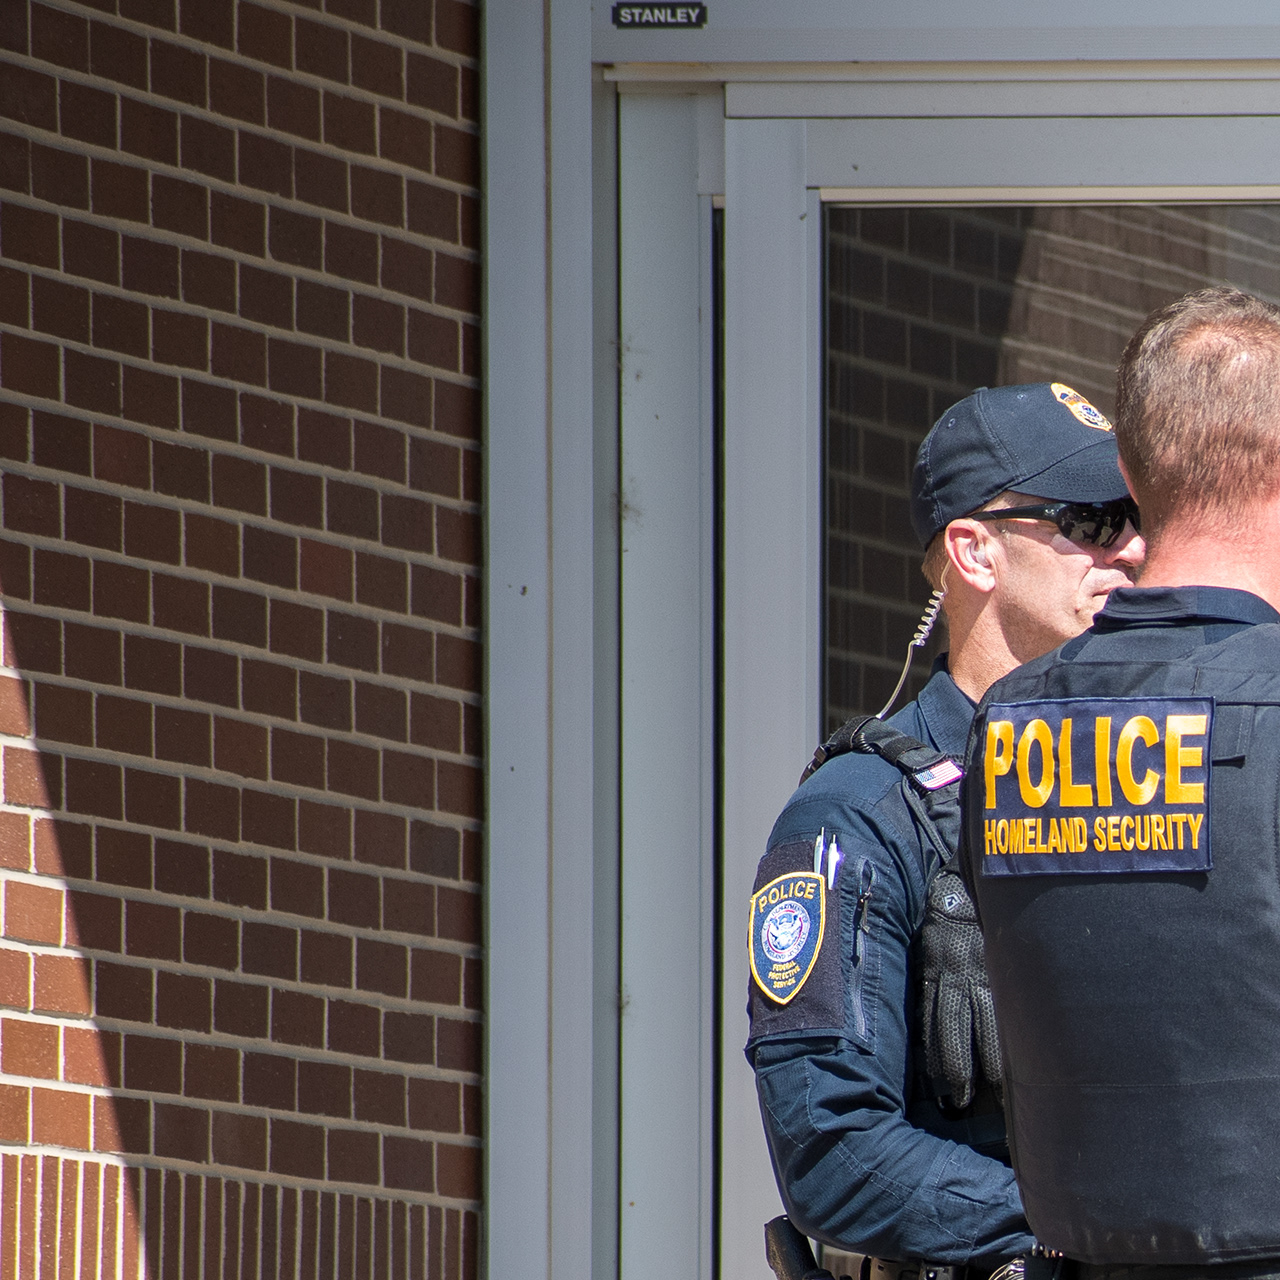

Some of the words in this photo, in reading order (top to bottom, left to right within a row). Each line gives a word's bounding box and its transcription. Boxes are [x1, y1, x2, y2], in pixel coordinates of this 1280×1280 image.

[619, 7, 700, 23] STANLEY
[984, 714, 1208, 809] POLICE
[984, 817, 1088, 855] HOMELAND
[1093, 813, 1204, 853] SECURITY
[758, 880, 818, 913] POLICE
